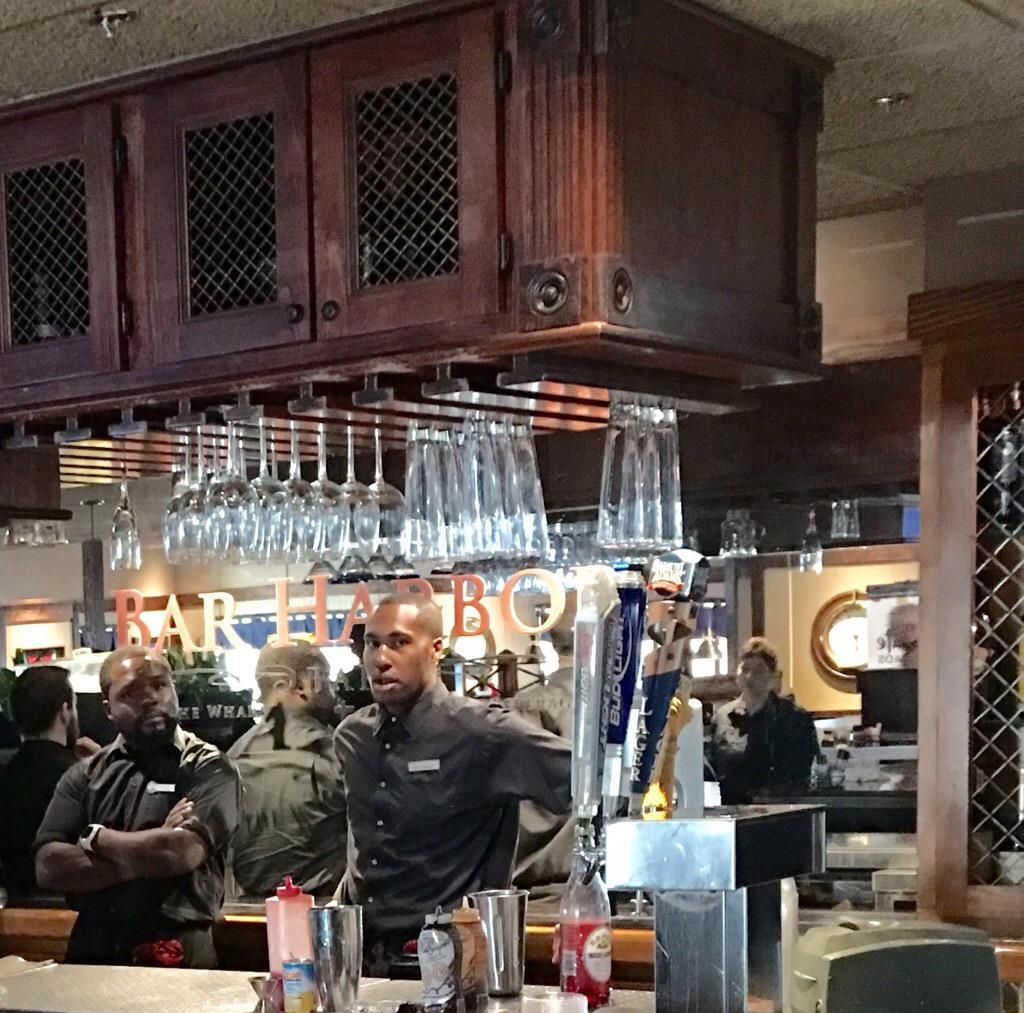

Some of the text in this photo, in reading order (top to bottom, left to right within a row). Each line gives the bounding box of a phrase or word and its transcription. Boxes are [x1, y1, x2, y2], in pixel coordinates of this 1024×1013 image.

[112, 587, 256, 652] BAR
[177, 704, 254, 720] HE WHA
[609, 681, 622, 727] BUD
[630, 697, 653, 782] LAGER
